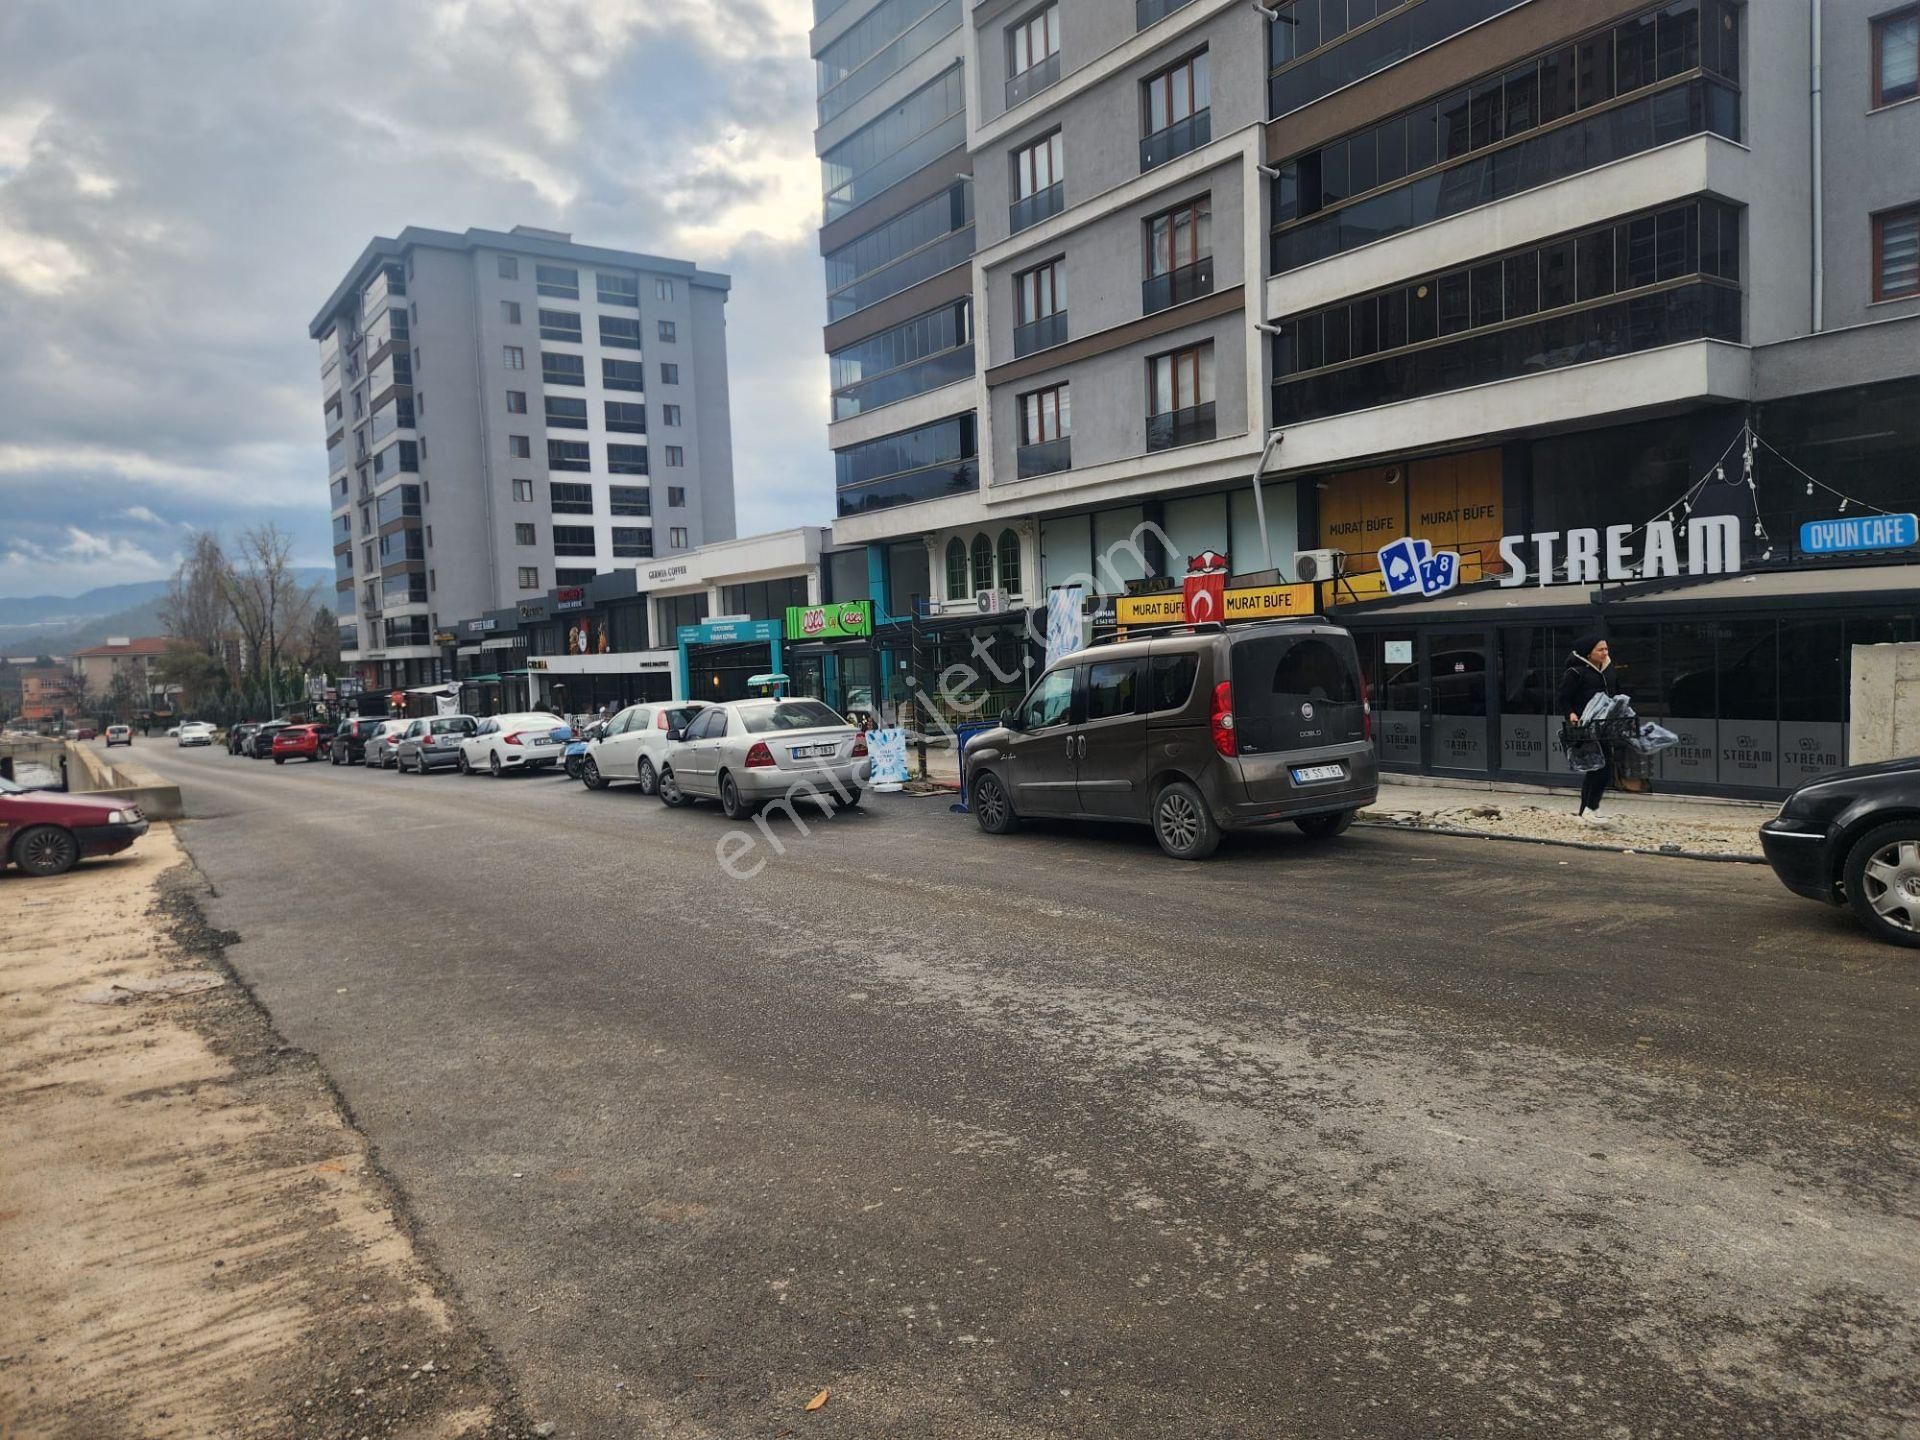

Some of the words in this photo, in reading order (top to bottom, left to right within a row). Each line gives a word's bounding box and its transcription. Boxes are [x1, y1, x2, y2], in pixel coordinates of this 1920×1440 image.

[1420, 508, 1459, 526] MURAT
[1463, 504, 1495, 521] BÜFE
[1329, 520, 1363, 536] MURAT
[1366, 516, 1394, 532] BÜFE
[1810, 521, 1859, 549] OYUN
[1862, 518, 1905, 547] CAFE
[1499, 514, 1741, 587] STREAM
[1132, 602, 1163, 616] MURAT
[1226, 595, 1263, 611] MURAT
[1263, 591, 1292, 608] BÜFE
[1504, 739, 1542, 751] STREAM
[1667, 746, 1712, 759] STREAM
[1723, 749, 1772, 763] STREAM
[1784, 752, 1837, 766] STREAM
